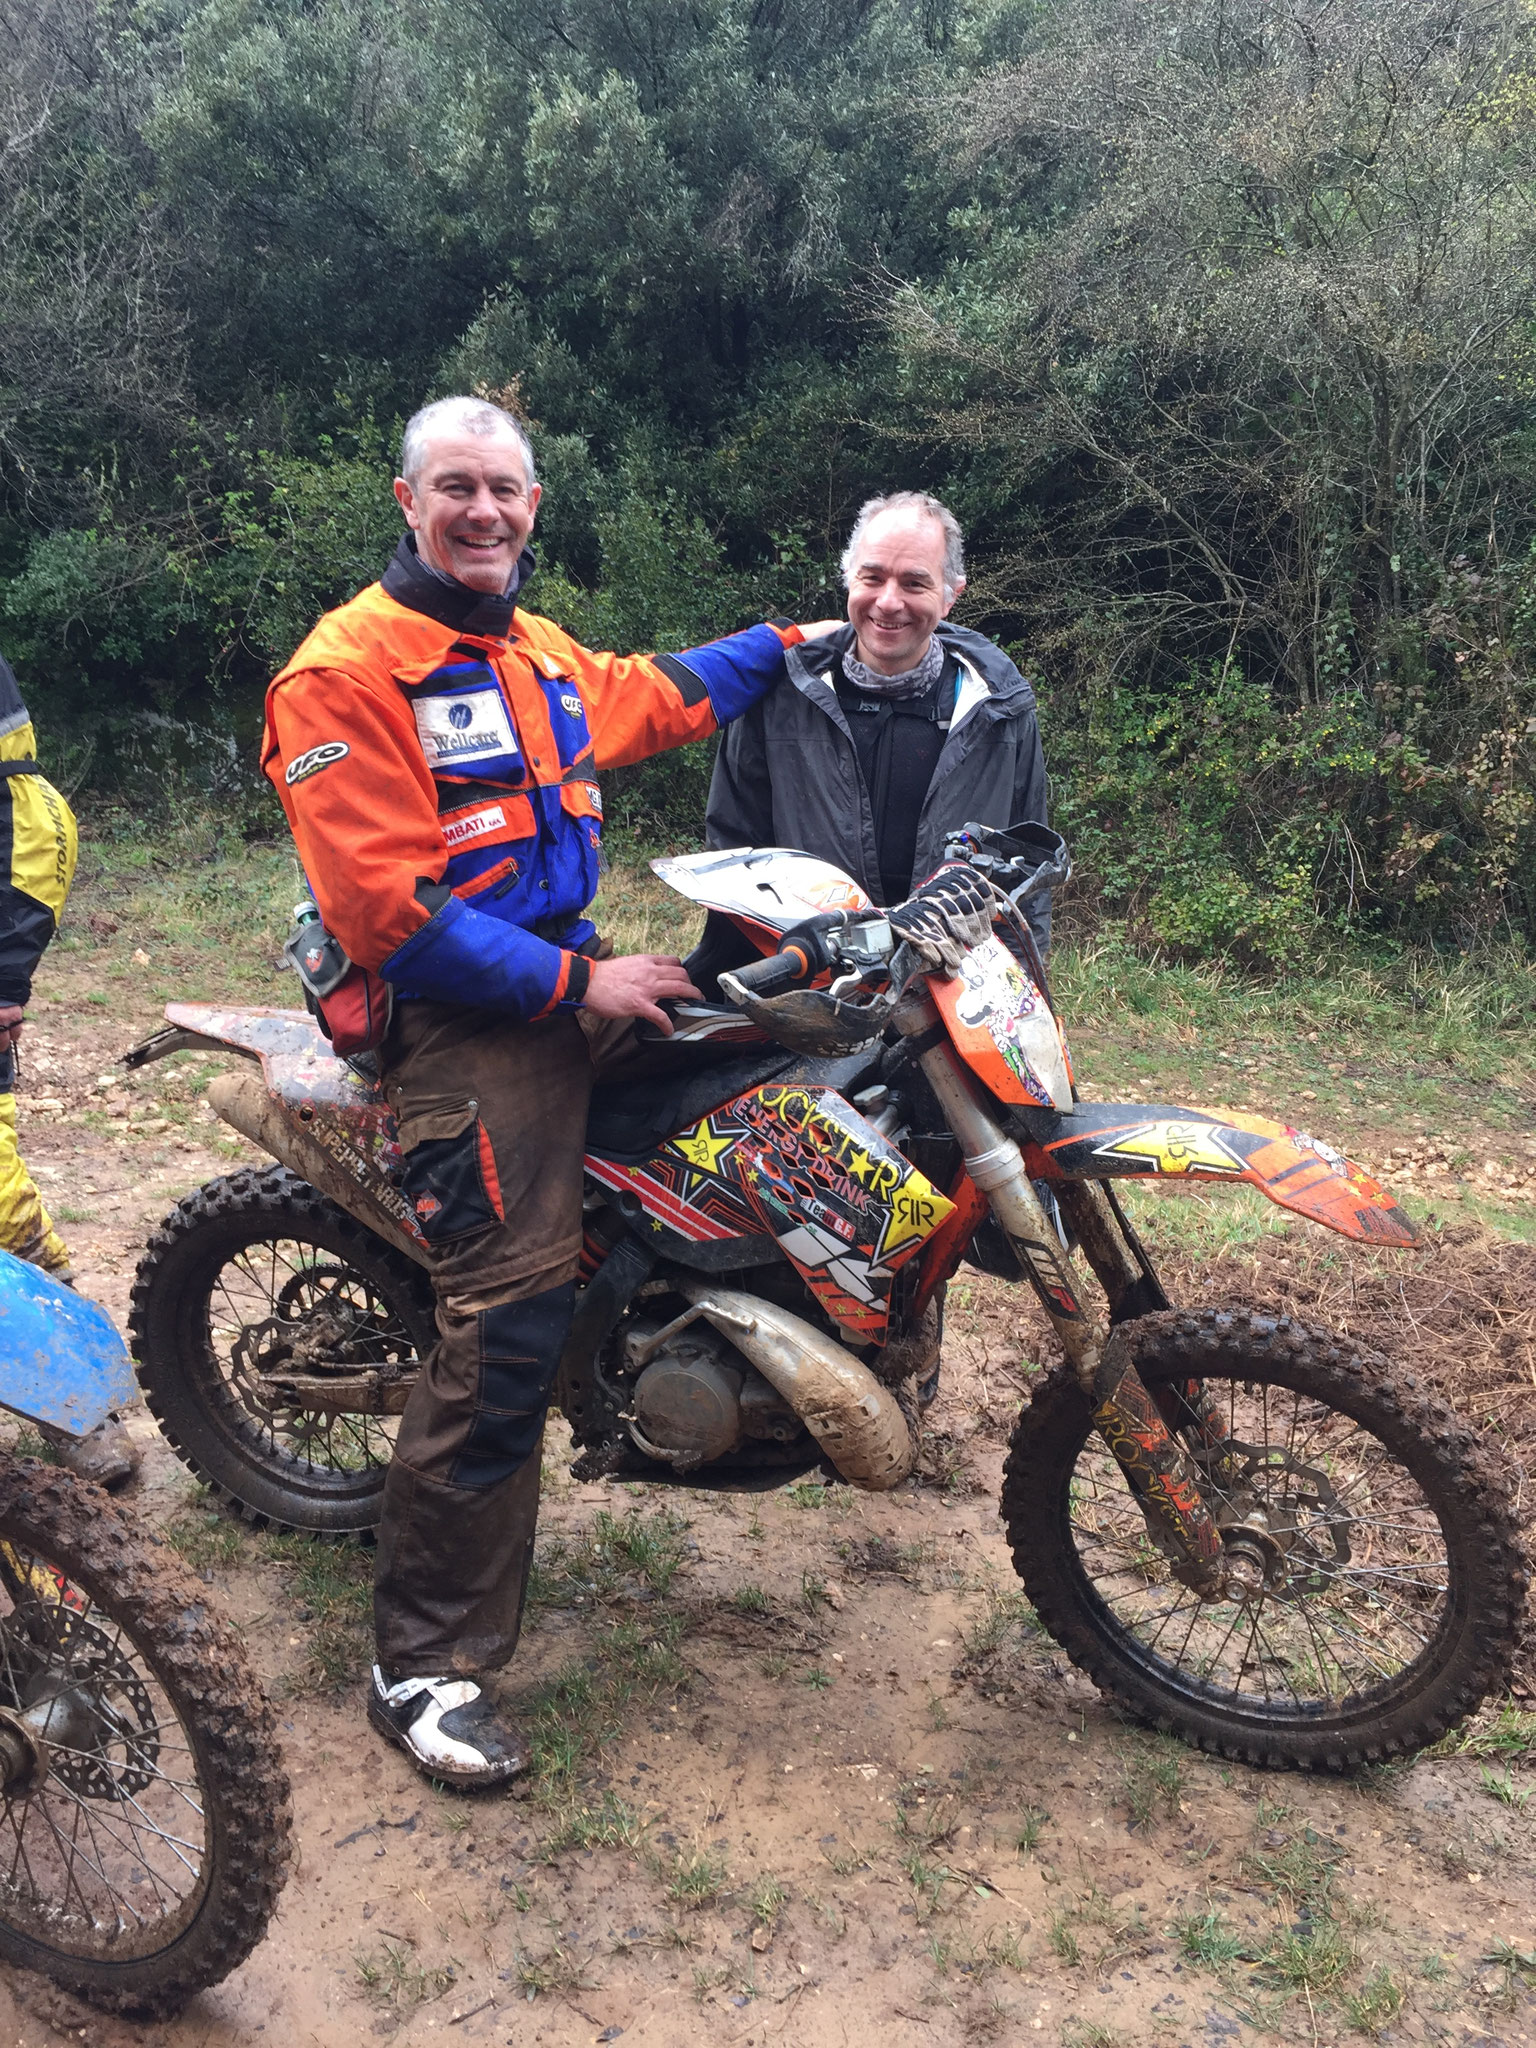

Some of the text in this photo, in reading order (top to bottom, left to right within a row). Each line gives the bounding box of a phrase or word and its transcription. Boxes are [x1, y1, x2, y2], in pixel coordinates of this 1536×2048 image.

[432, 730, 499, 750] Wellcare
[286, 742, 349, 784] UFO
[736, 1099, 803, 1160] ENERGY
[812, 1155, 872, 1212] DRINK
